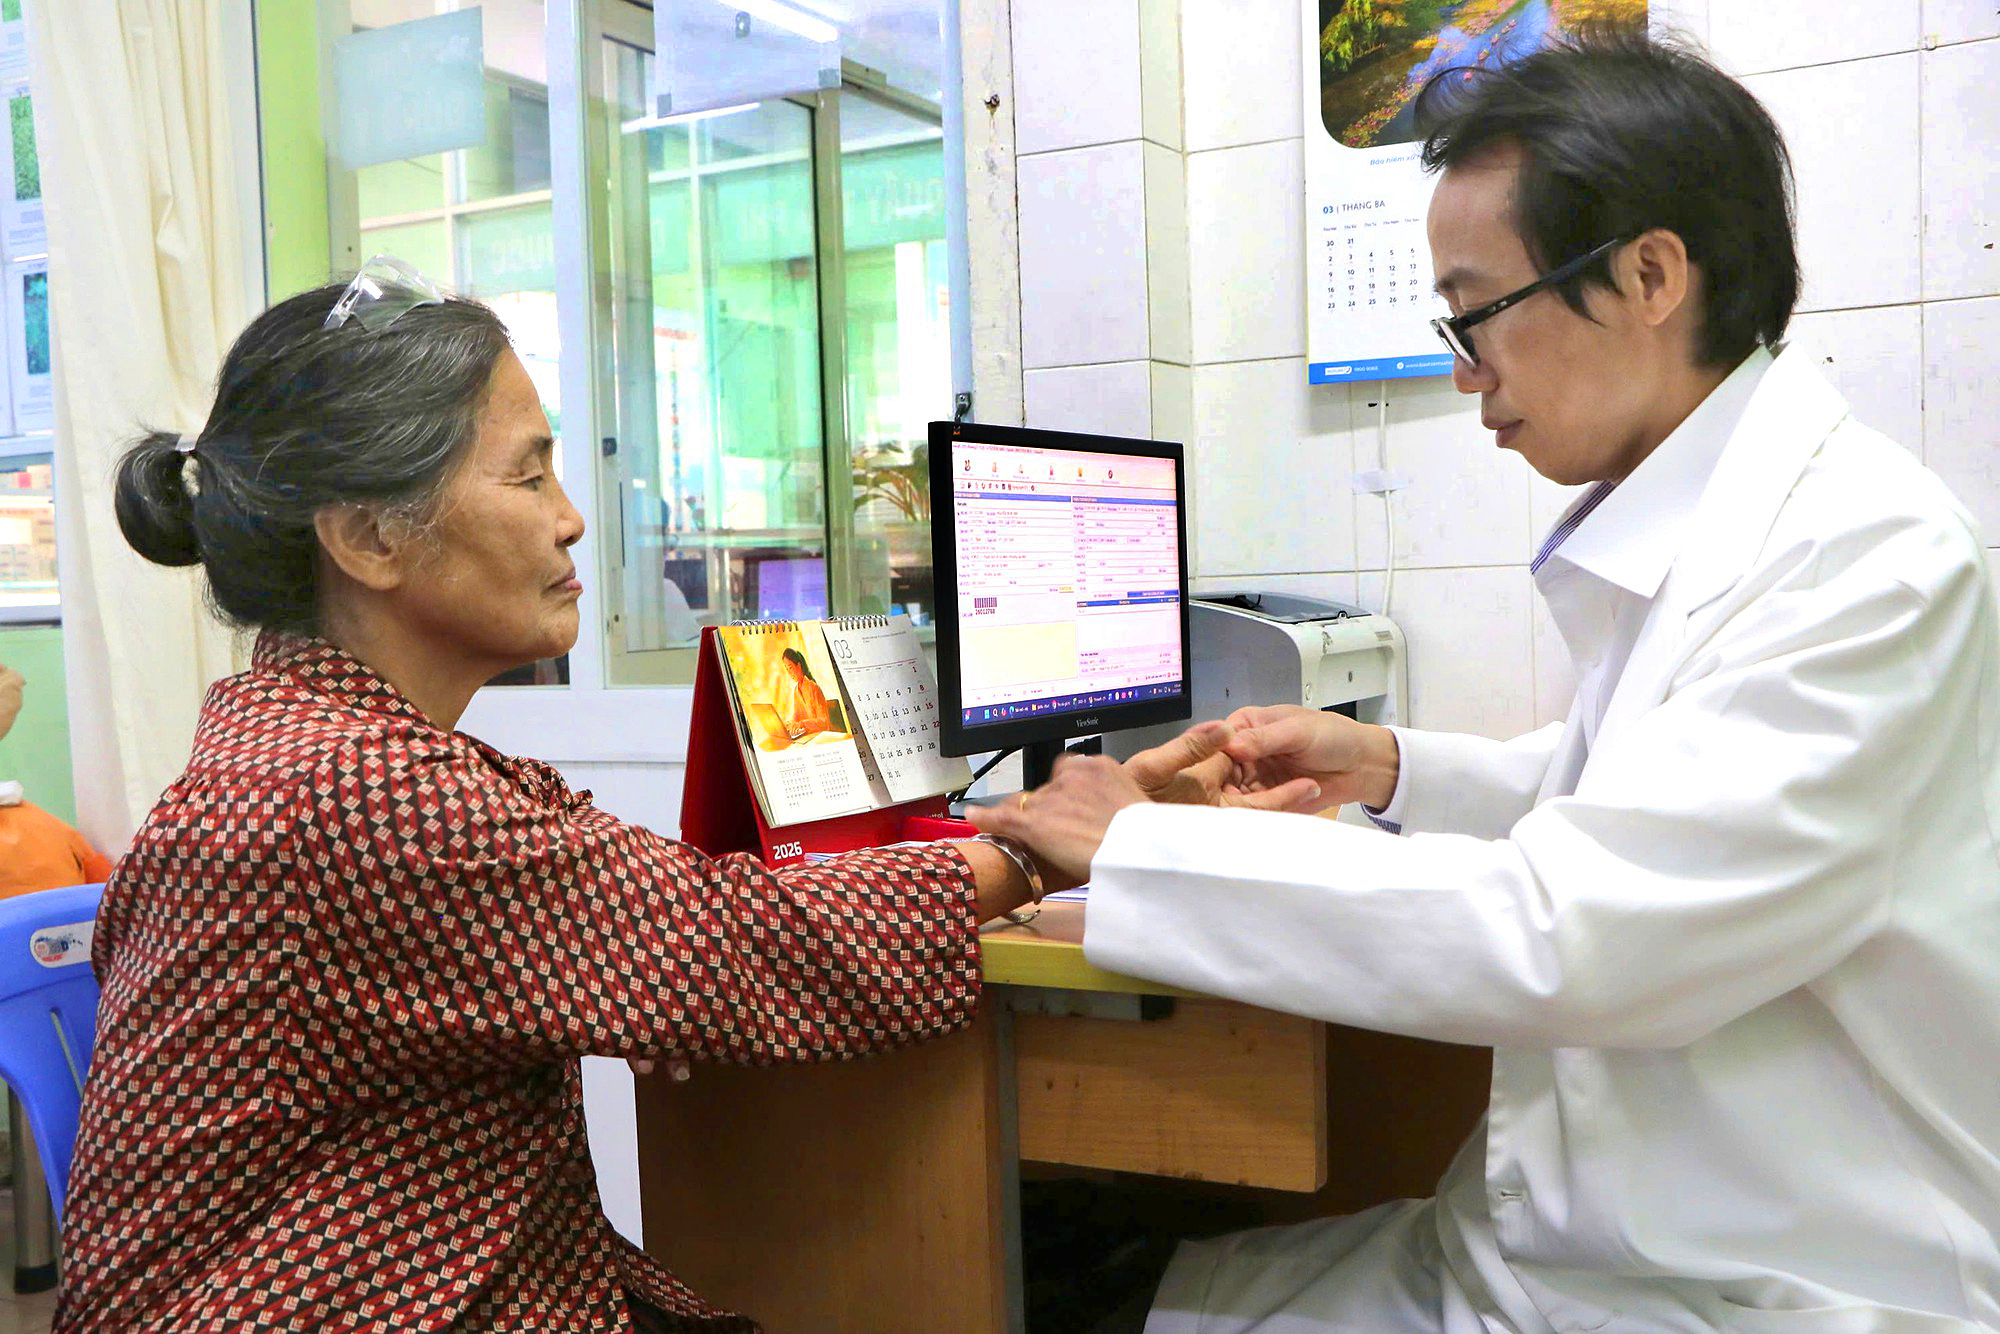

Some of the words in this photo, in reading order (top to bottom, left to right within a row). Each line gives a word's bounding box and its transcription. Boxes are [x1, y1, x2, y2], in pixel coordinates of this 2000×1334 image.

[1323, 206, 1334, 214] 03
[834, 640, 852, 659] 03
[1076, 716, 1099, 727] ViewSonic
[773, 841, 802, 860] 2026
